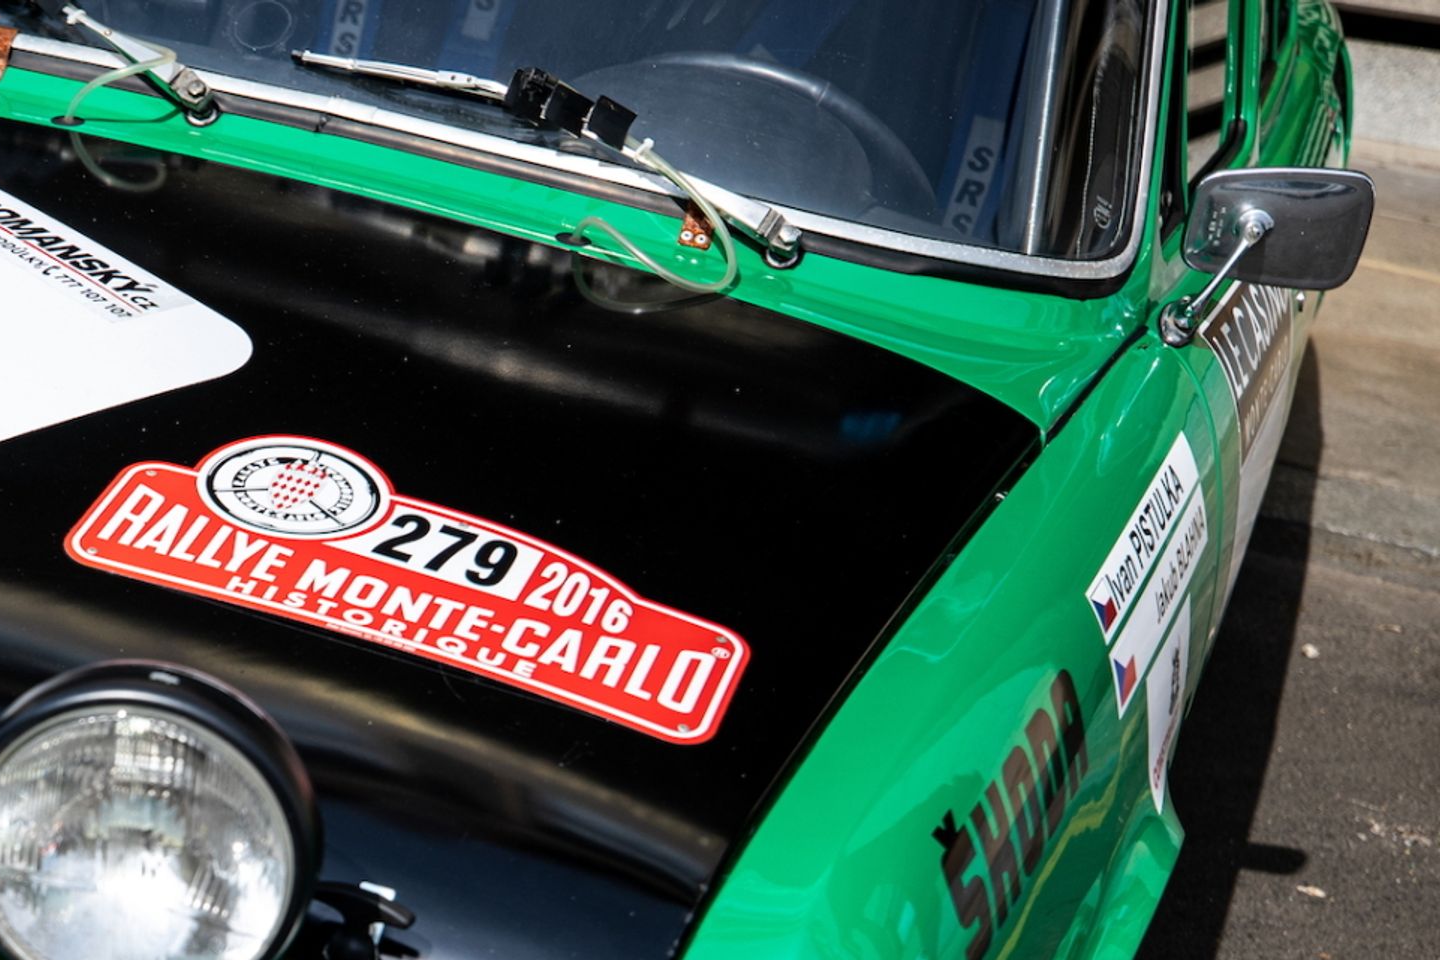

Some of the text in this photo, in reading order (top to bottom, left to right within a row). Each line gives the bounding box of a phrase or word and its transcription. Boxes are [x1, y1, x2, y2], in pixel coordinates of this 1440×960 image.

[97, 484, 294, 582] RALLYE
[295, 559, 717, 714] MONTE-CARLO
[371, 514, 633, 634] 279 2016
[1105, 464, 1184, 611] Ivan PISTULKA
[226, 577, 539, 679] HISTORIQUE
